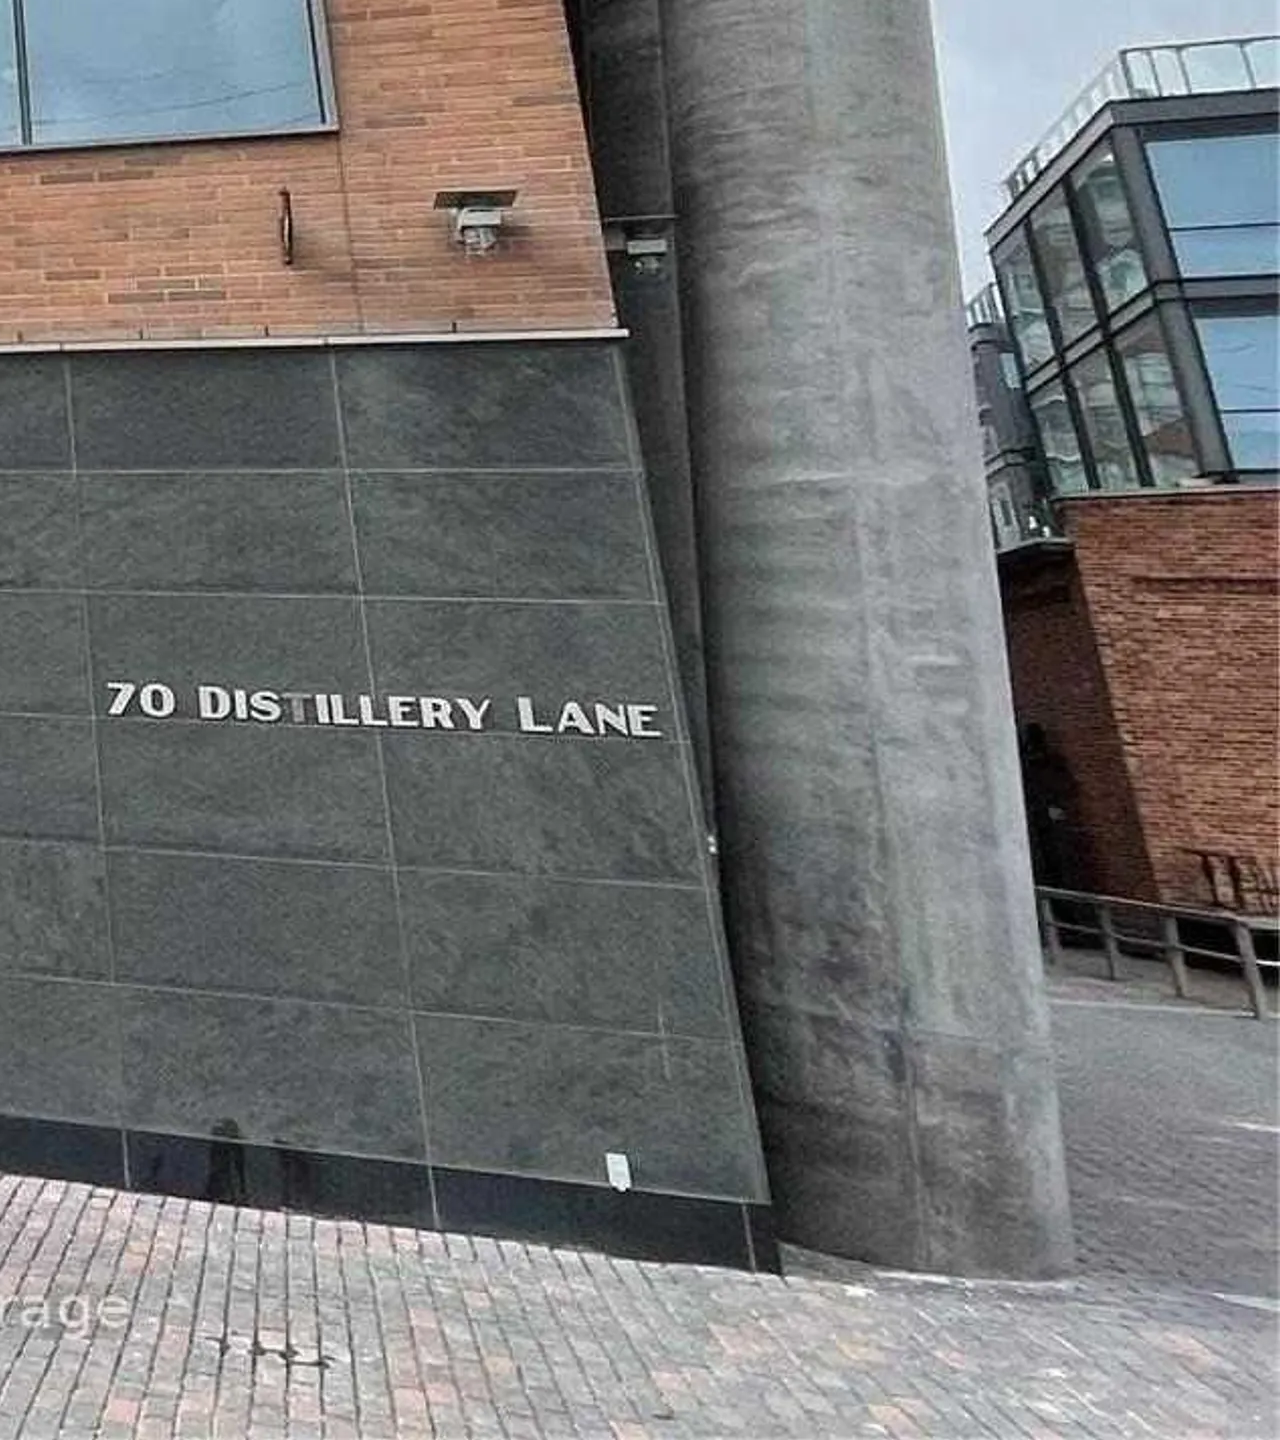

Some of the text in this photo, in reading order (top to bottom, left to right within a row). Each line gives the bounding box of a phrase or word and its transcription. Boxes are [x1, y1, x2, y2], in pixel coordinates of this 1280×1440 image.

[107, 682, 662, 738] 70 DISTILLERY LANE
